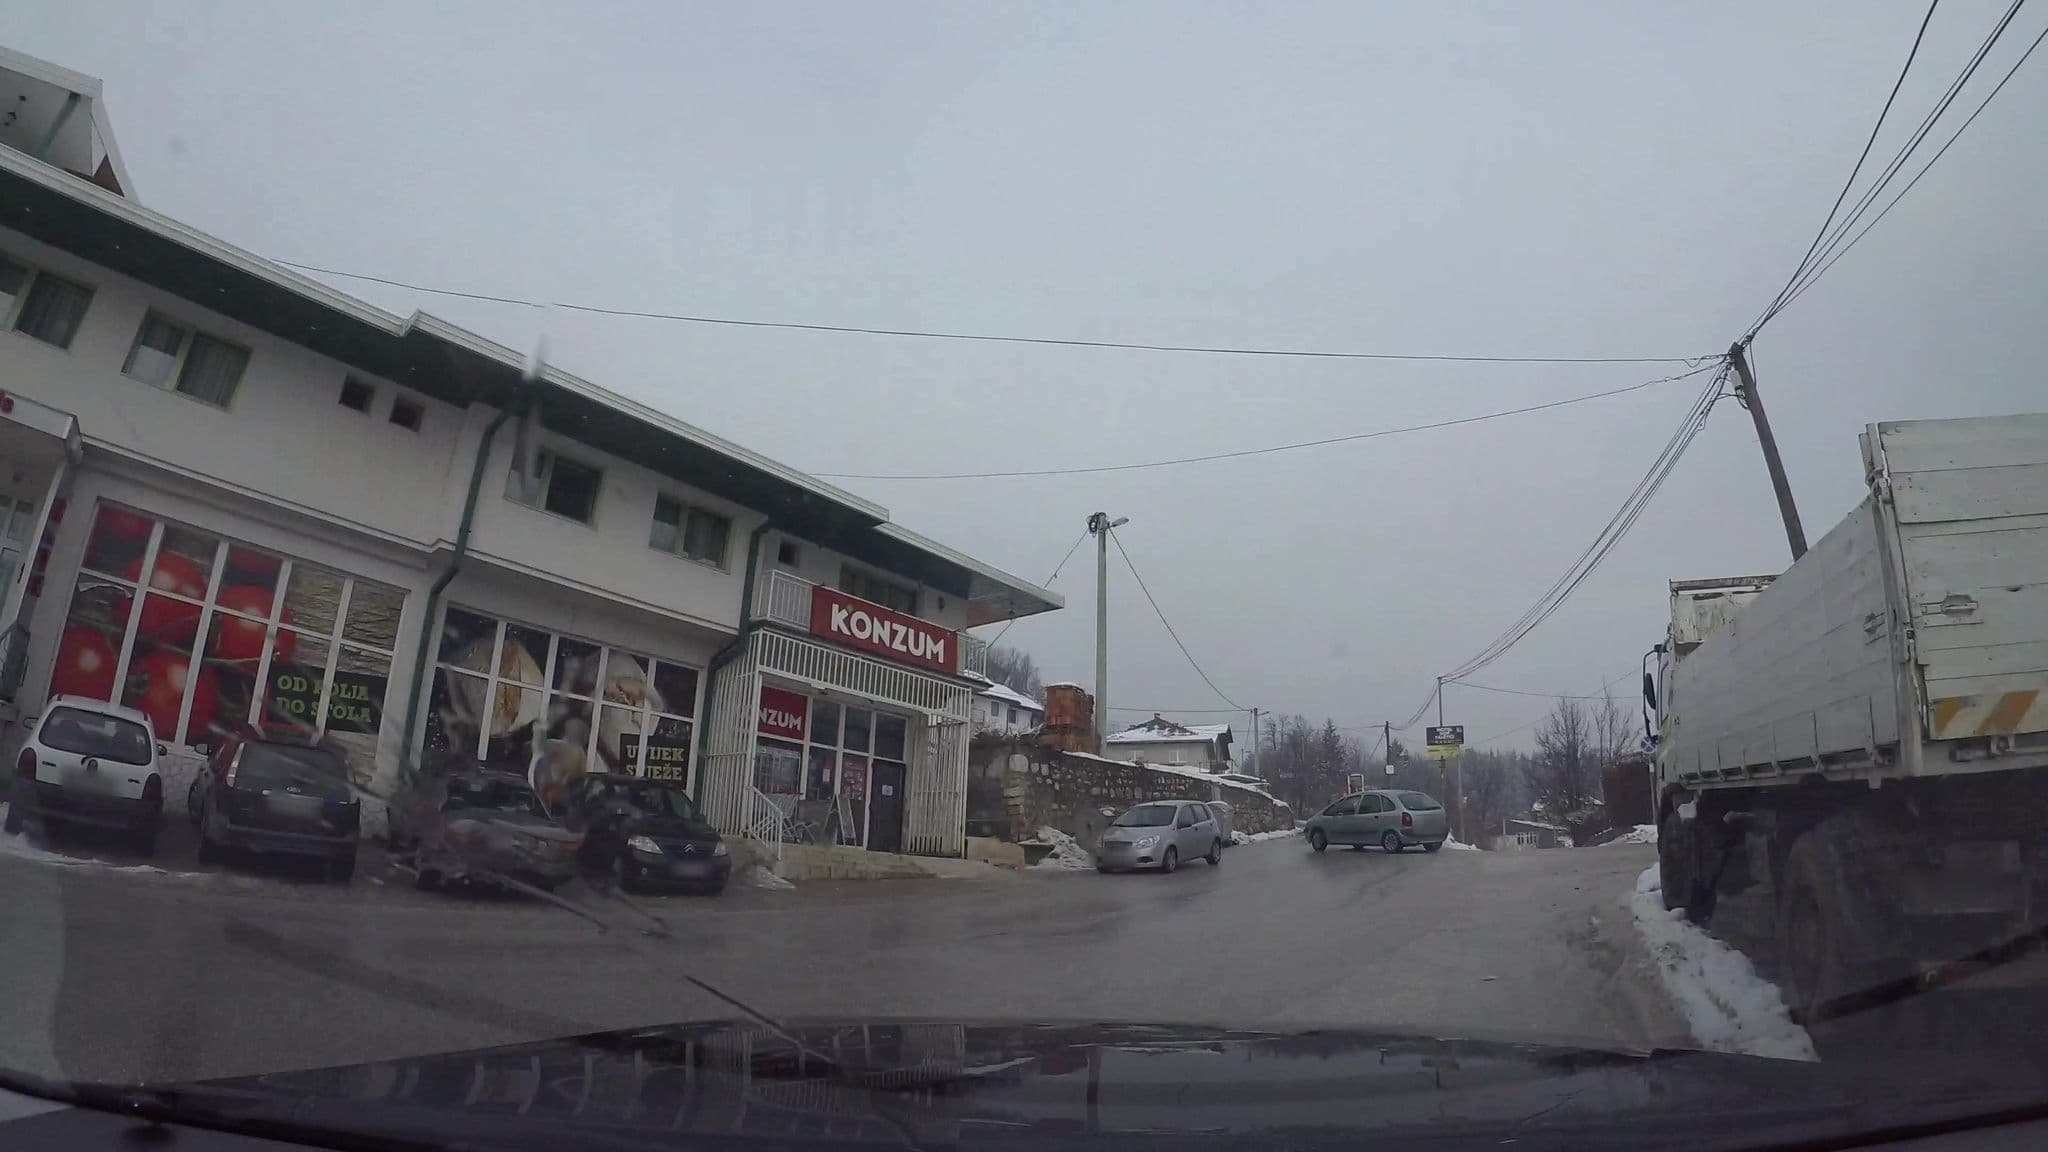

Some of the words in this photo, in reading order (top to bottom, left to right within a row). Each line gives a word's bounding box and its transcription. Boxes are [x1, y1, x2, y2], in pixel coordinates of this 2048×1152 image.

[831, 603, 945, 664] KONZUM
[277, 675, 308, 692] OD
[276, 697, 306, 714] DO
[310, 701, 372, 722] SOLA
[758, 707, 802, 731] NZUM
[626, 744, 685, 761] UIJEK
[625, 762, 682, 780] SJEŽE
